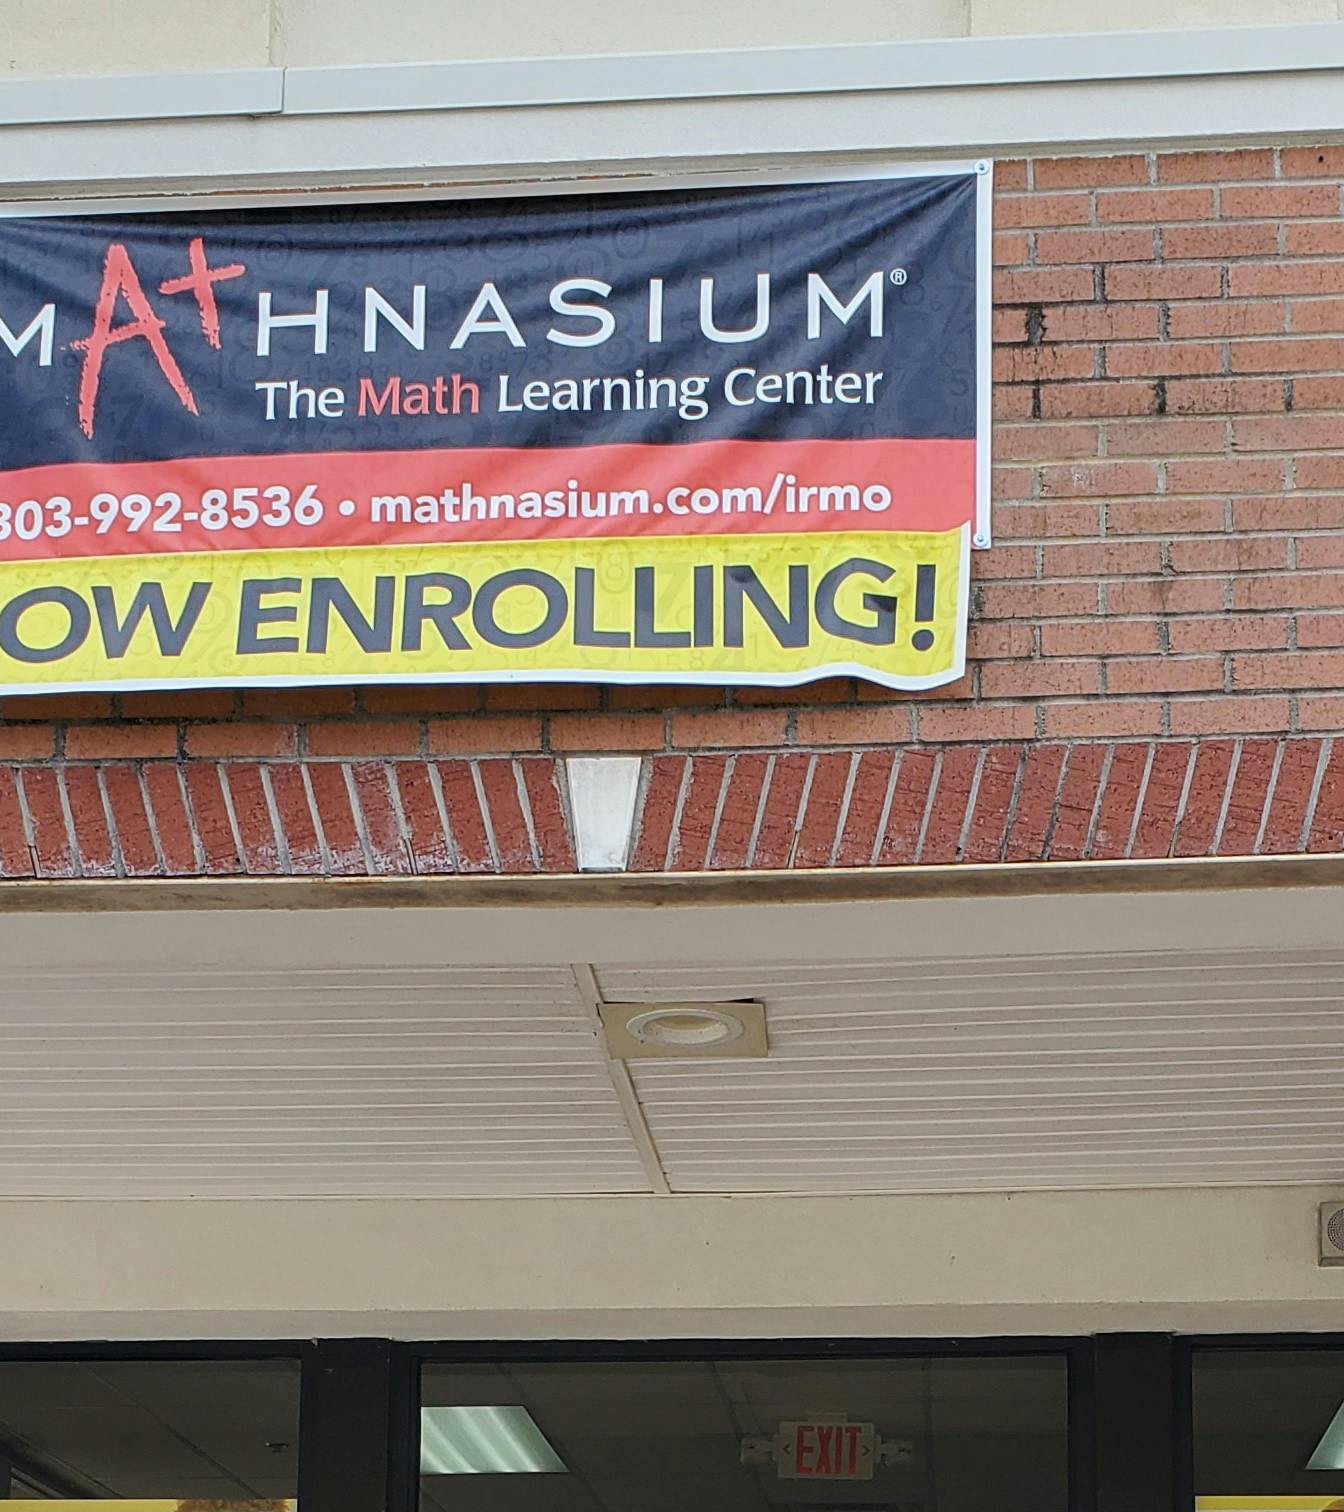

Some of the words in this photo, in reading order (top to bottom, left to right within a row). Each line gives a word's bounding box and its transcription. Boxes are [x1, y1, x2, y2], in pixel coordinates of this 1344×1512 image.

[256, 379, 346, 423] The
[357, 373, 481, 418] Math
[498, 368, 711, 423] Learning
[723, 366, 884, 411] Center
[370, 472, 892, 526] mathnasium.com/irmo
[234, 555, 937, 657] ENROLLING!
[795, 1425, 862, 1475] EXIT
